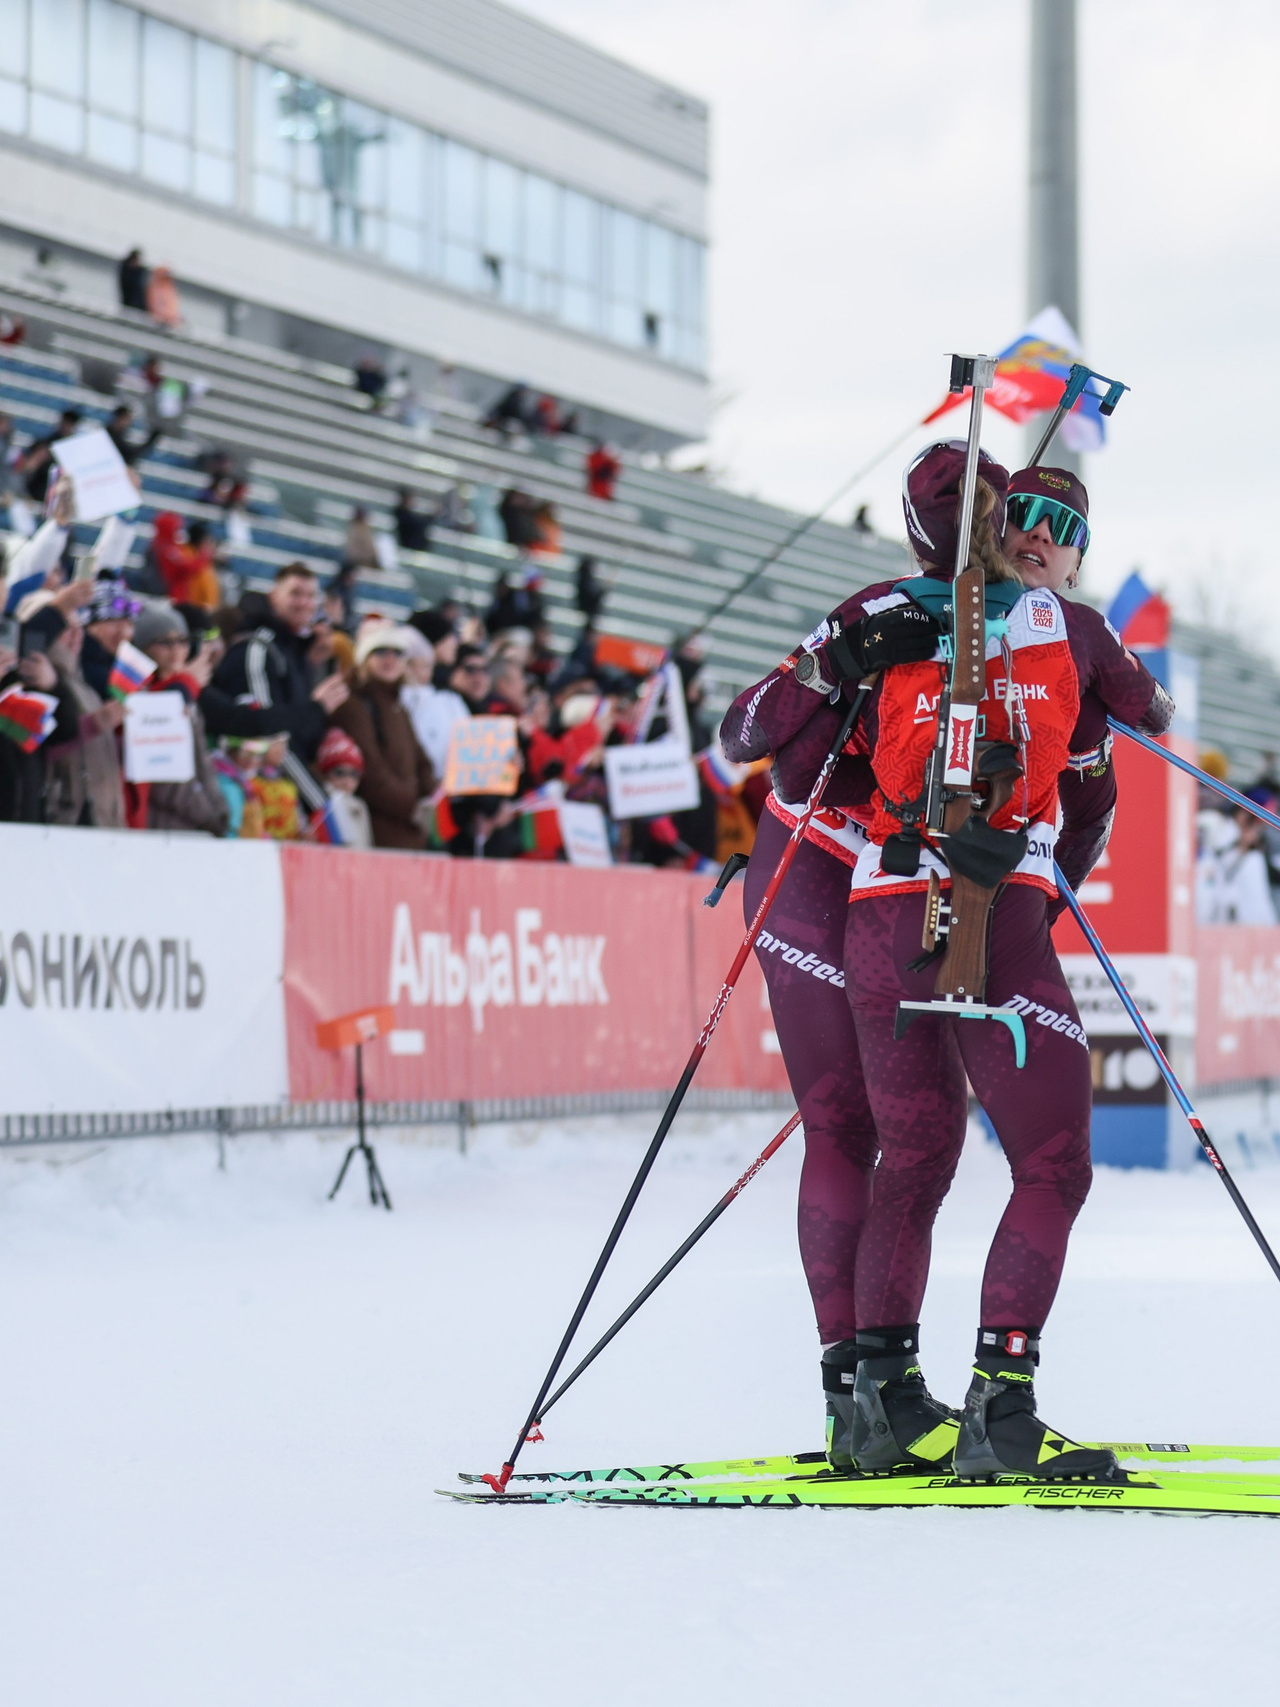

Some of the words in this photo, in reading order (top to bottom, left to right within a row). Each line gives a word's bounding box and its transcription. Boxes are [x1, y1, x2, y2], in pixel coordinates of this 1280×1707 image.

[1031, 600, 1051, 610] СЕЗОН
[903, 611, 930, 623] MOAX
[1033, 618, 1053, 628] 2026
[790, 753, 834, 842] MOAX
[388, 901, 515, 1034] Альфа
[516, 908, 610, 1006] Банк
[1023, 1487, 1124, 1500] FISCHER
